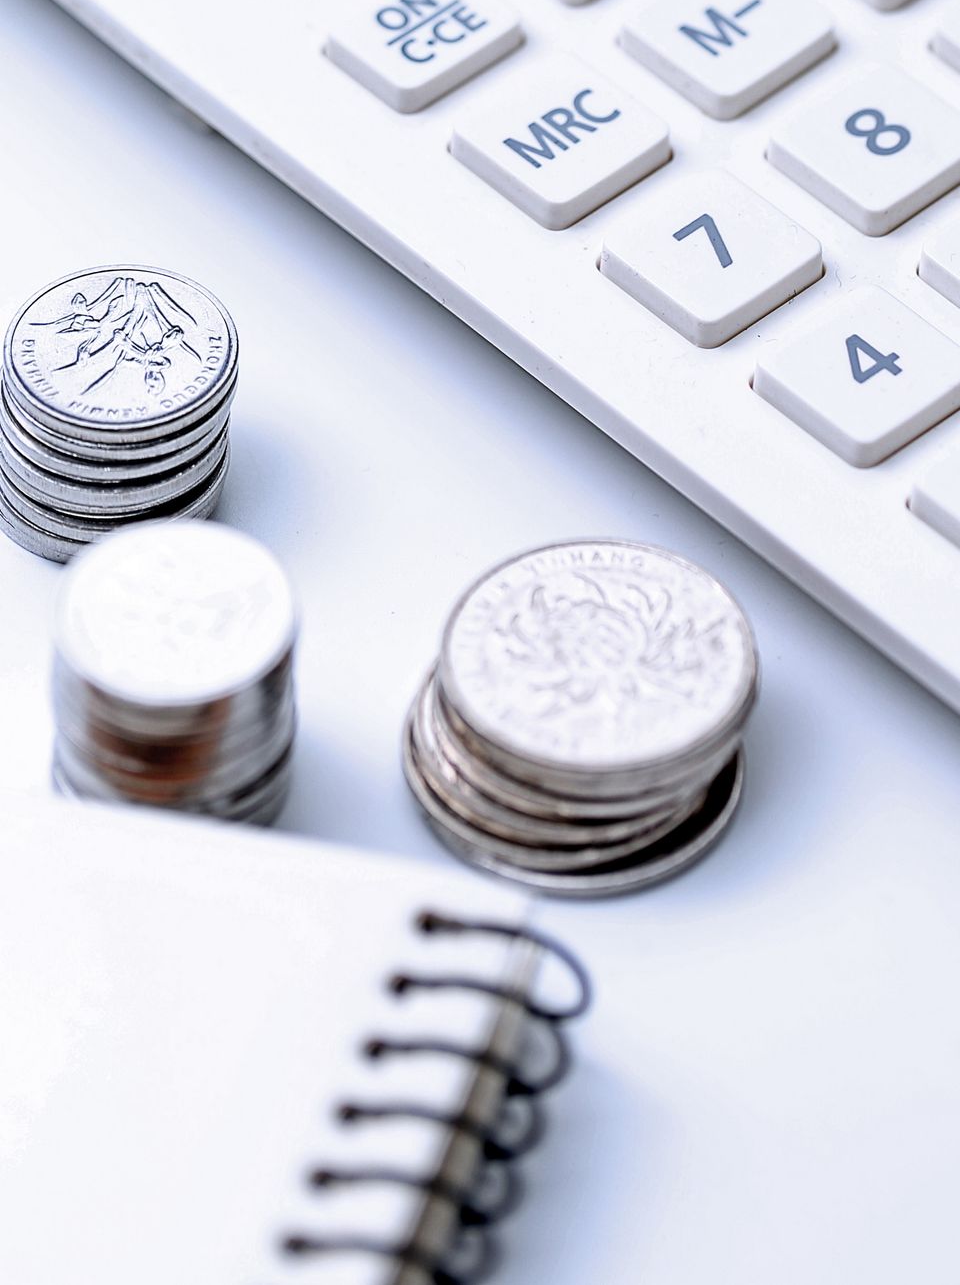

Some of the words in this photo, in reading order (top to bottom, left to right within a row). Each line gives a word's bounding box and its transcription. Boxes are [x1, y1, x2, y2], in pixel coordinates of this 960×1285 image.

[502, 88, 621, 169] MRC
[845, 108, 911, 156] 8
[672, 214, 733, 268] 7
[845, 334, 903, 384] 4
